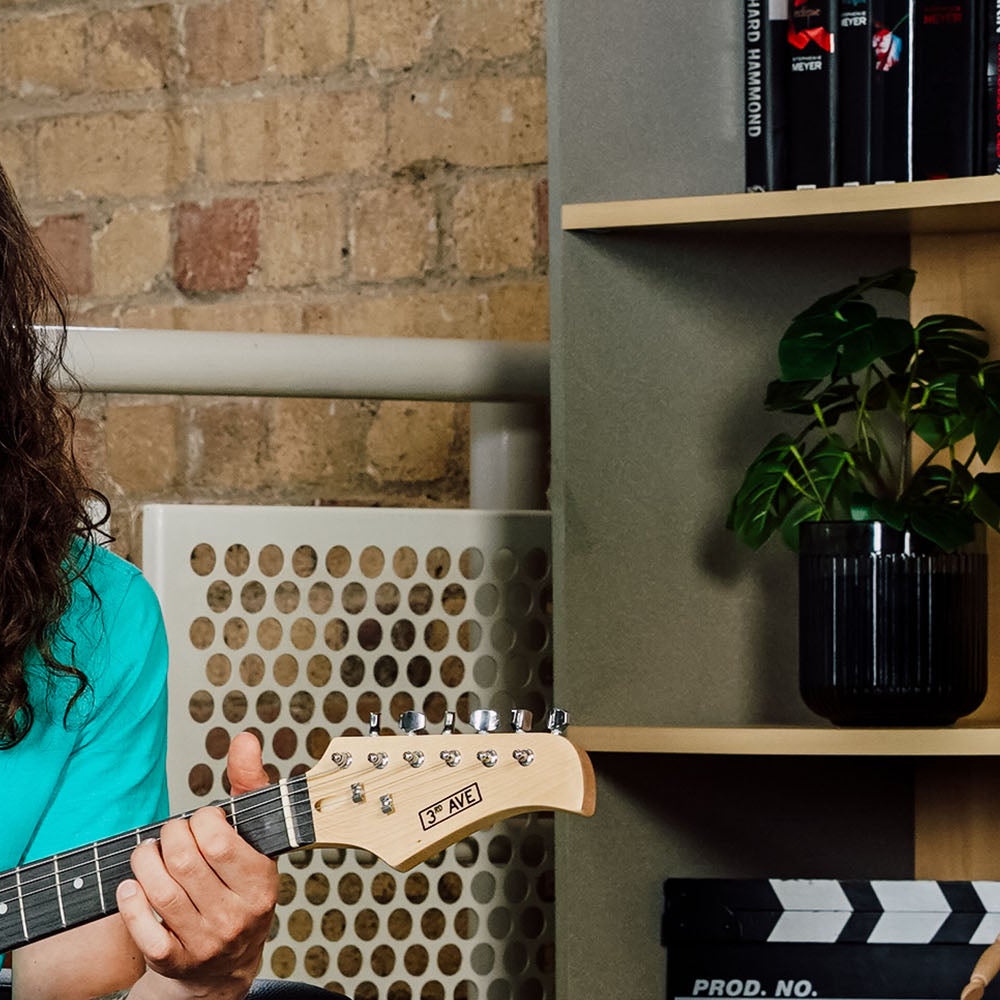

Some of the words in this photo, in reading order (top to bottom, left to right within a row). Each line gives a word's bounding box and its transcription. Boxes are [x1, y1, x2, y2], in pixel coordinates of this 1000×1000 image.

[747, 48, 762, 138] HAMMOND
[448, 788, 476, 814] AVE
[692, 979, 767, 998] PROD.
[774, 979, 818, 998] NO.
